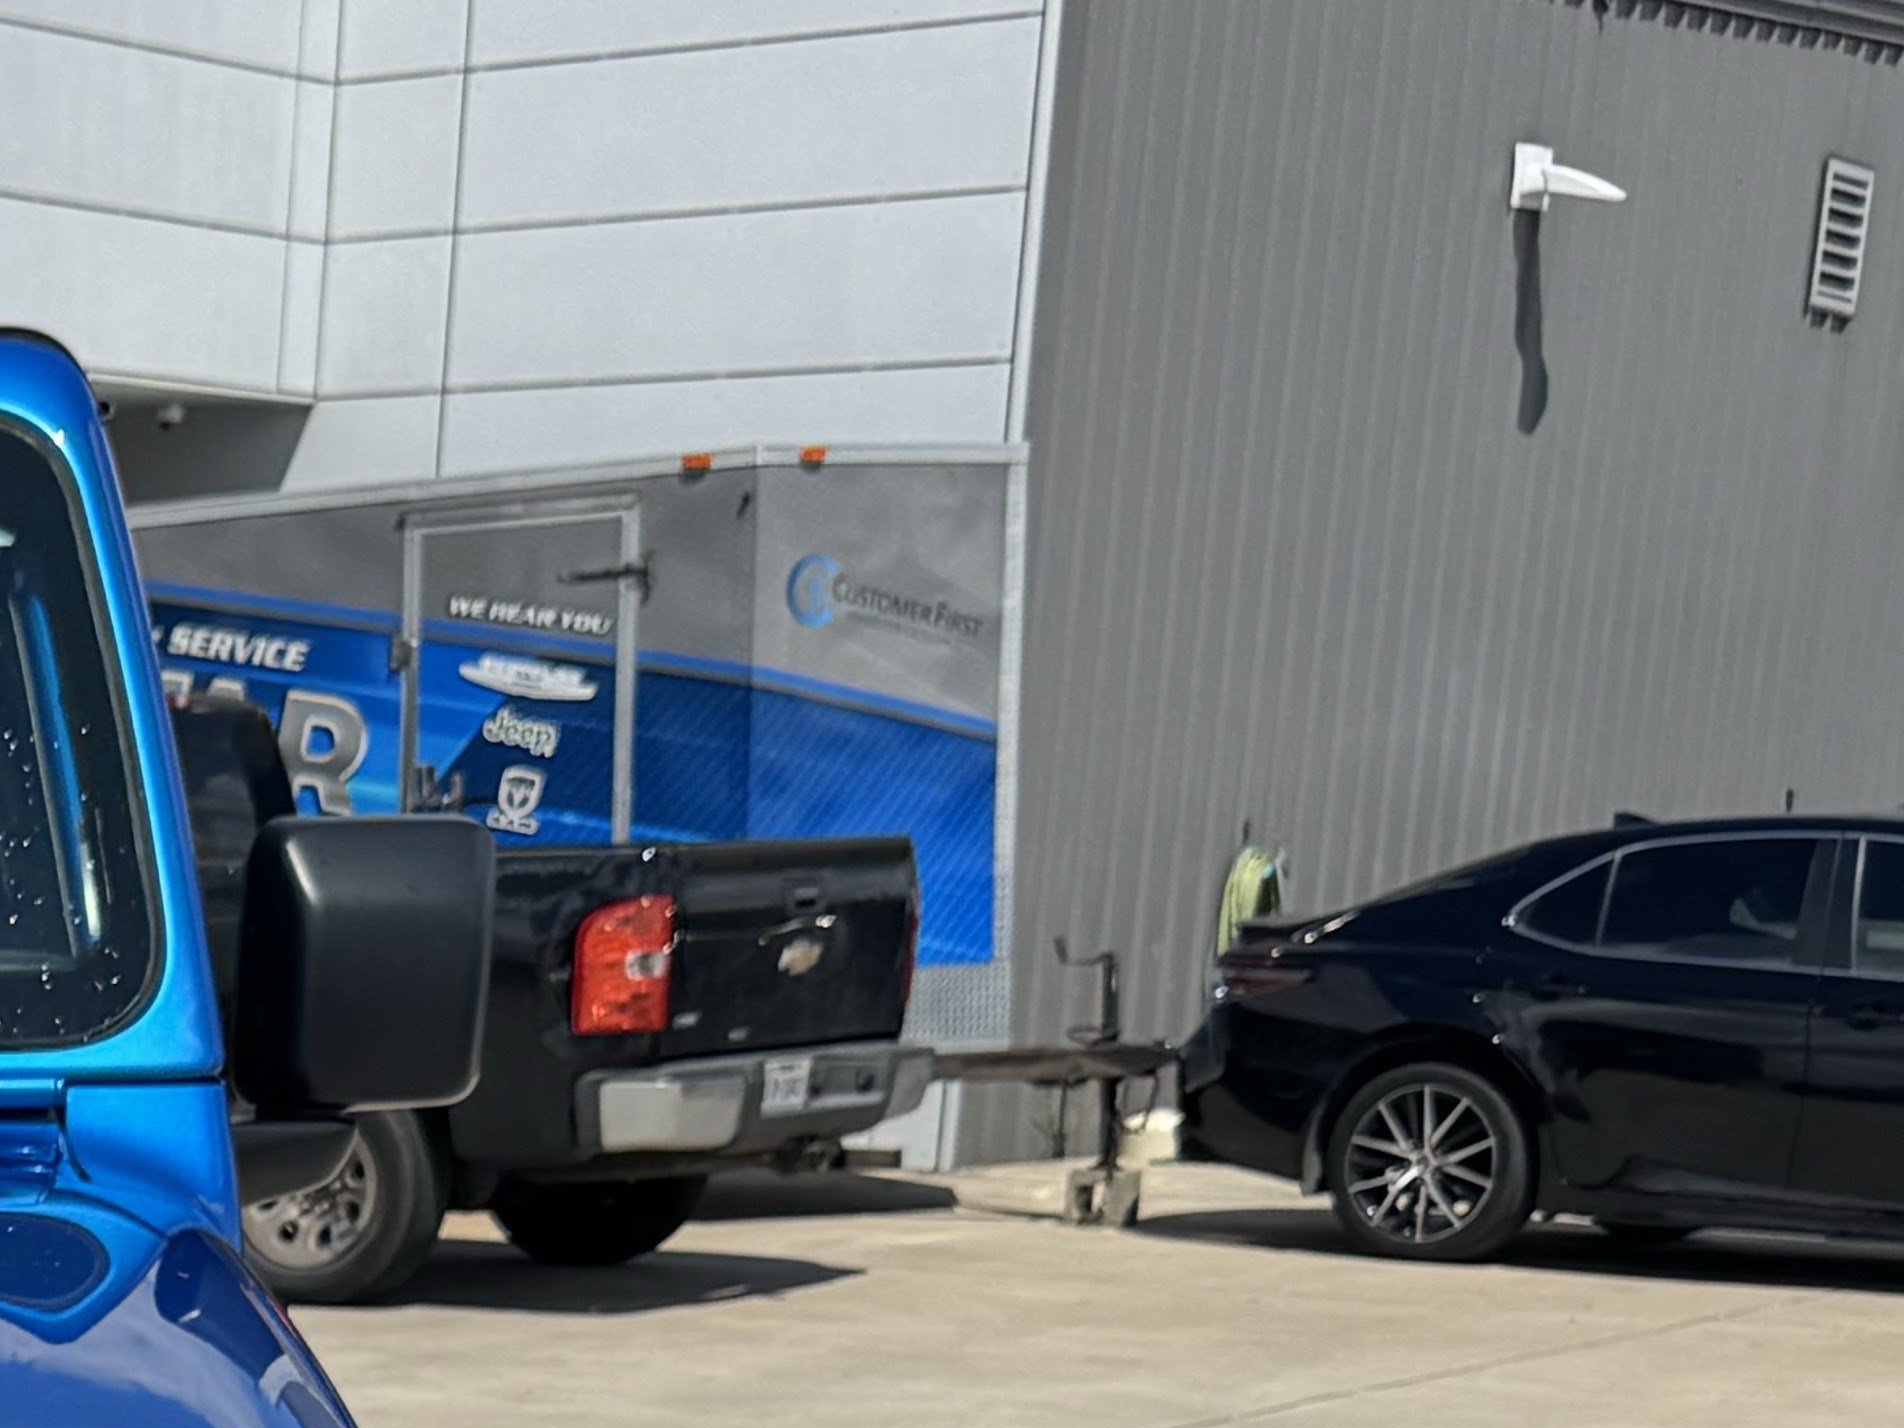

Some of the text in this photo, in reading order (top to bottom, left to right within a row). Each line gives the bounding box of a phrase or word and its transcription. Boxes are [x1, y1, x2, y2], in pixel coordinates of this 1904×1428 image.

[449, 597, 616, 636] WE HEAR YOU
[167, 622, 313, 672] SERVICE
[483, 706, 560, 758] Jeep
